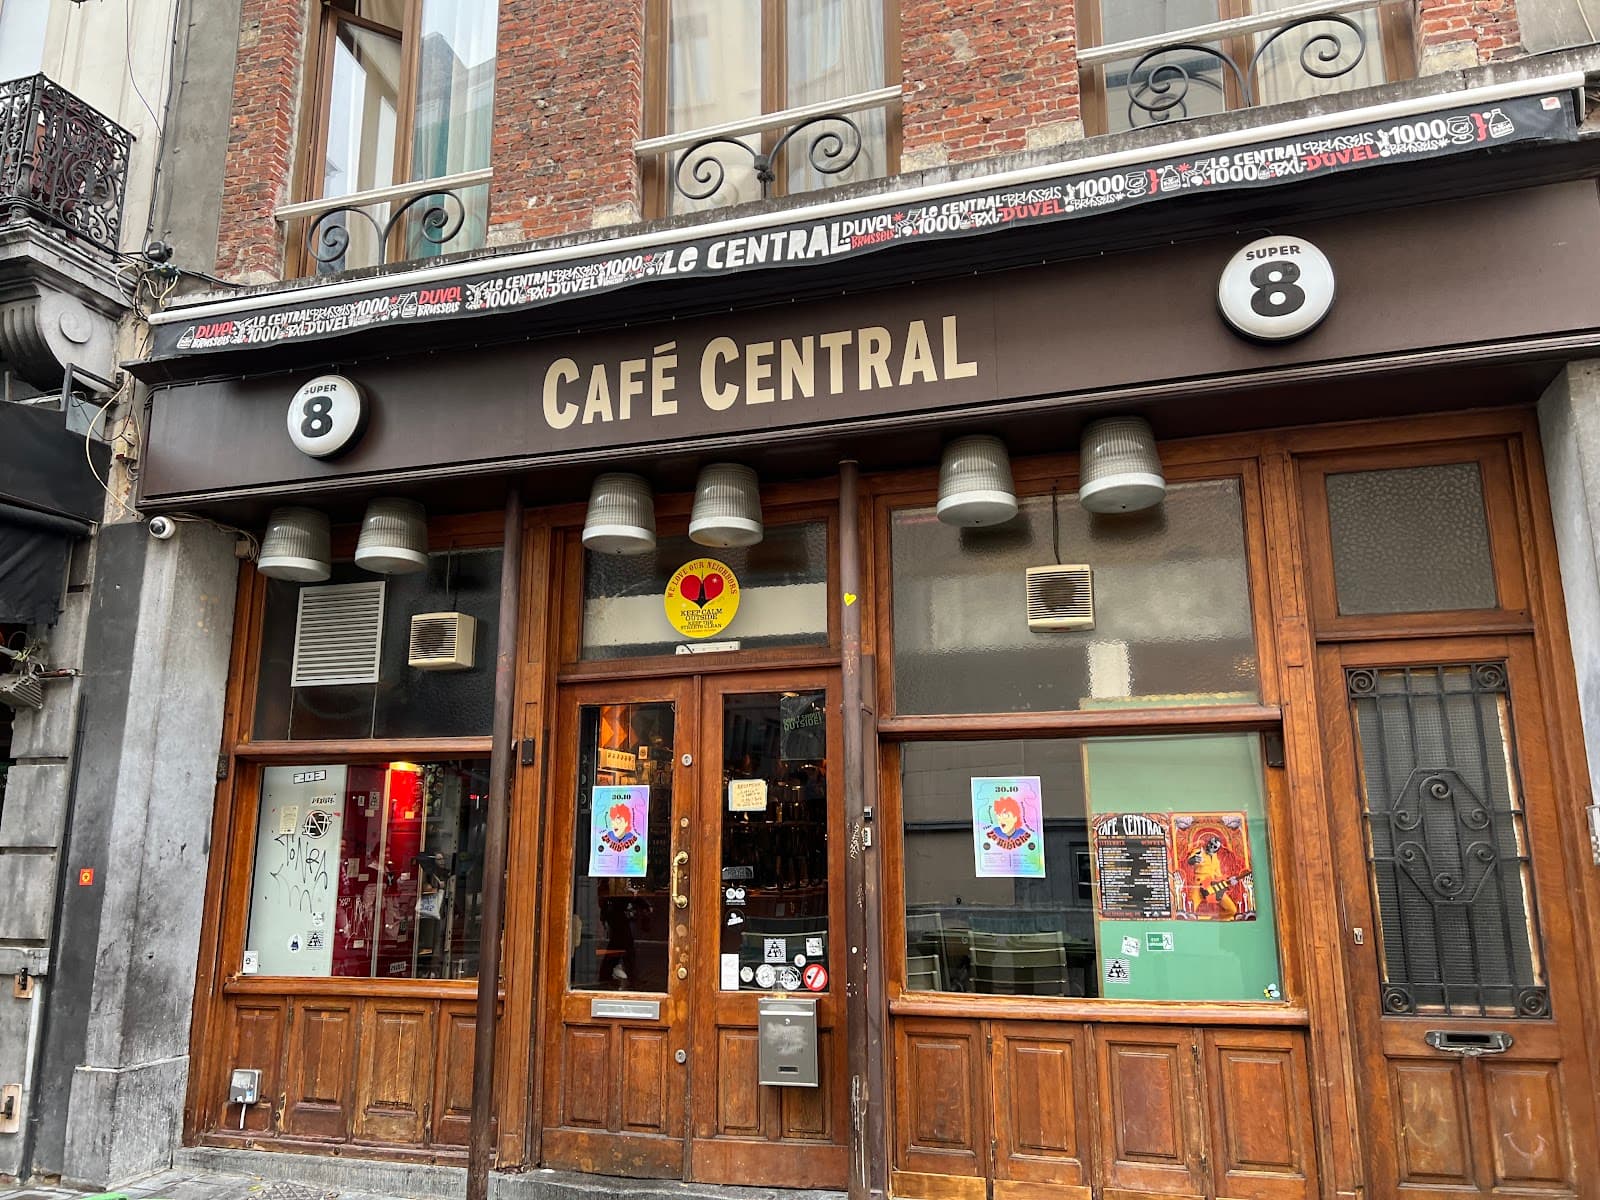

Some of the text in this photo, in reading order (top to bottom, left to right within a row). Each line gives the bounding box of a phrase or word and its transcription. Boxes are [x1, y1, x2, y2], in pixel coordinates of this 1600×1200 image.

[1233, 145, 1305, 166] CENTRAL
[1388, 119, 1446, 145] 1000
[1207, 165, 1257, 185] 1000
[1301, 145, 1380, 171] DUVEL
[941, 195, 1004, 215] CENTRAL
[1075, 174, 1125, 199] 1000
[916, 213, 960, 235] 1000
[998, 198, 1065, 222] DUVEL
[706, 221, 851, 270] CENTRAL
[1245, 244, 1301, 261] SUPER
[505, 270, 554, 289] CENTRAL
[604, 255, 643, 279] 1000
[1250, 260, 1306, 317] 8
[486, 288, 519, 308] 1000
[549, 275, 598, 298] DUVEL
[248, 325, 279, 343] 1000
[306, 316, 349, 335] DUVEL
[267, 309, 311, 326] CENTRAL
[355, 296, 390, 318] 1000
[542, 315, 978, 429] CAFÉ CENTRAL
[301, 396, 333, 438] 8
[672, 568, 688, 586] LOVE
[1123, 814, 1165, 836] CENTRAL
